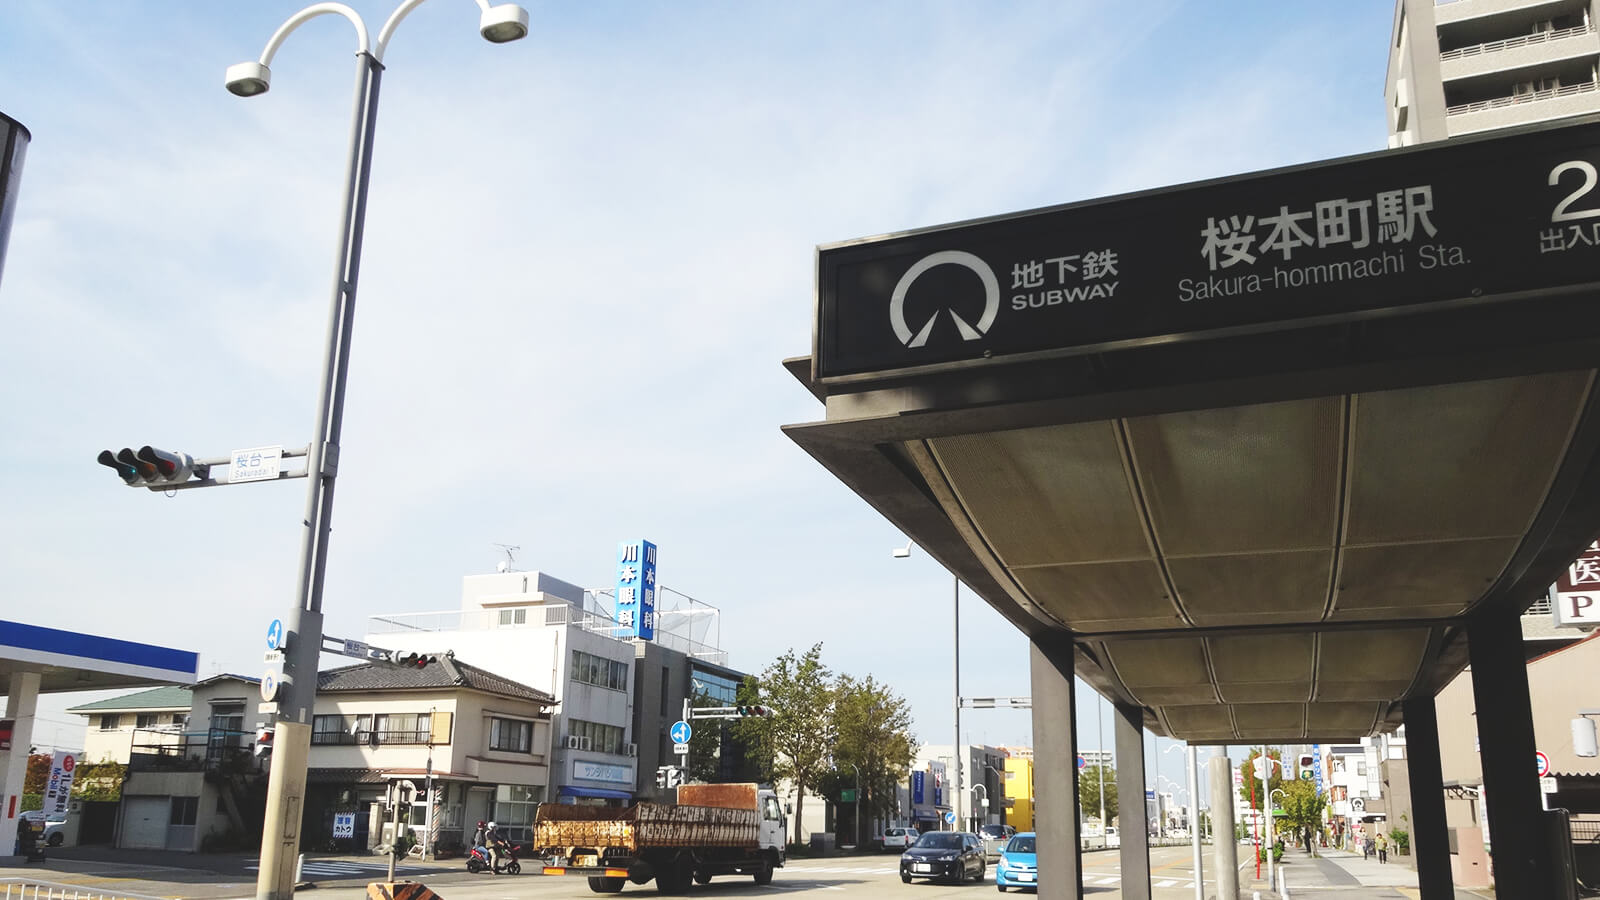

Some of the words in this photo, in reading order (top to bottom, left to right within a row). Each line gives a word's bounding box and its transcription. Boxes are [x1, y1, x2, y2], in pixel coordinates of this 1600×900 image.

[1548, 160, 1600, 222] 2
[1200, 184, 1438, 271] 桜本町駅
[1011, 248, 1119, 289] 地下鉄
[1178, 249, 1405, 302] Sakura-hommachi
[1418, 243, 1471, 270] Sta.
[1011, 281, 1119, 311] SUBWAY
[1568, 595, 1593, 618] P
